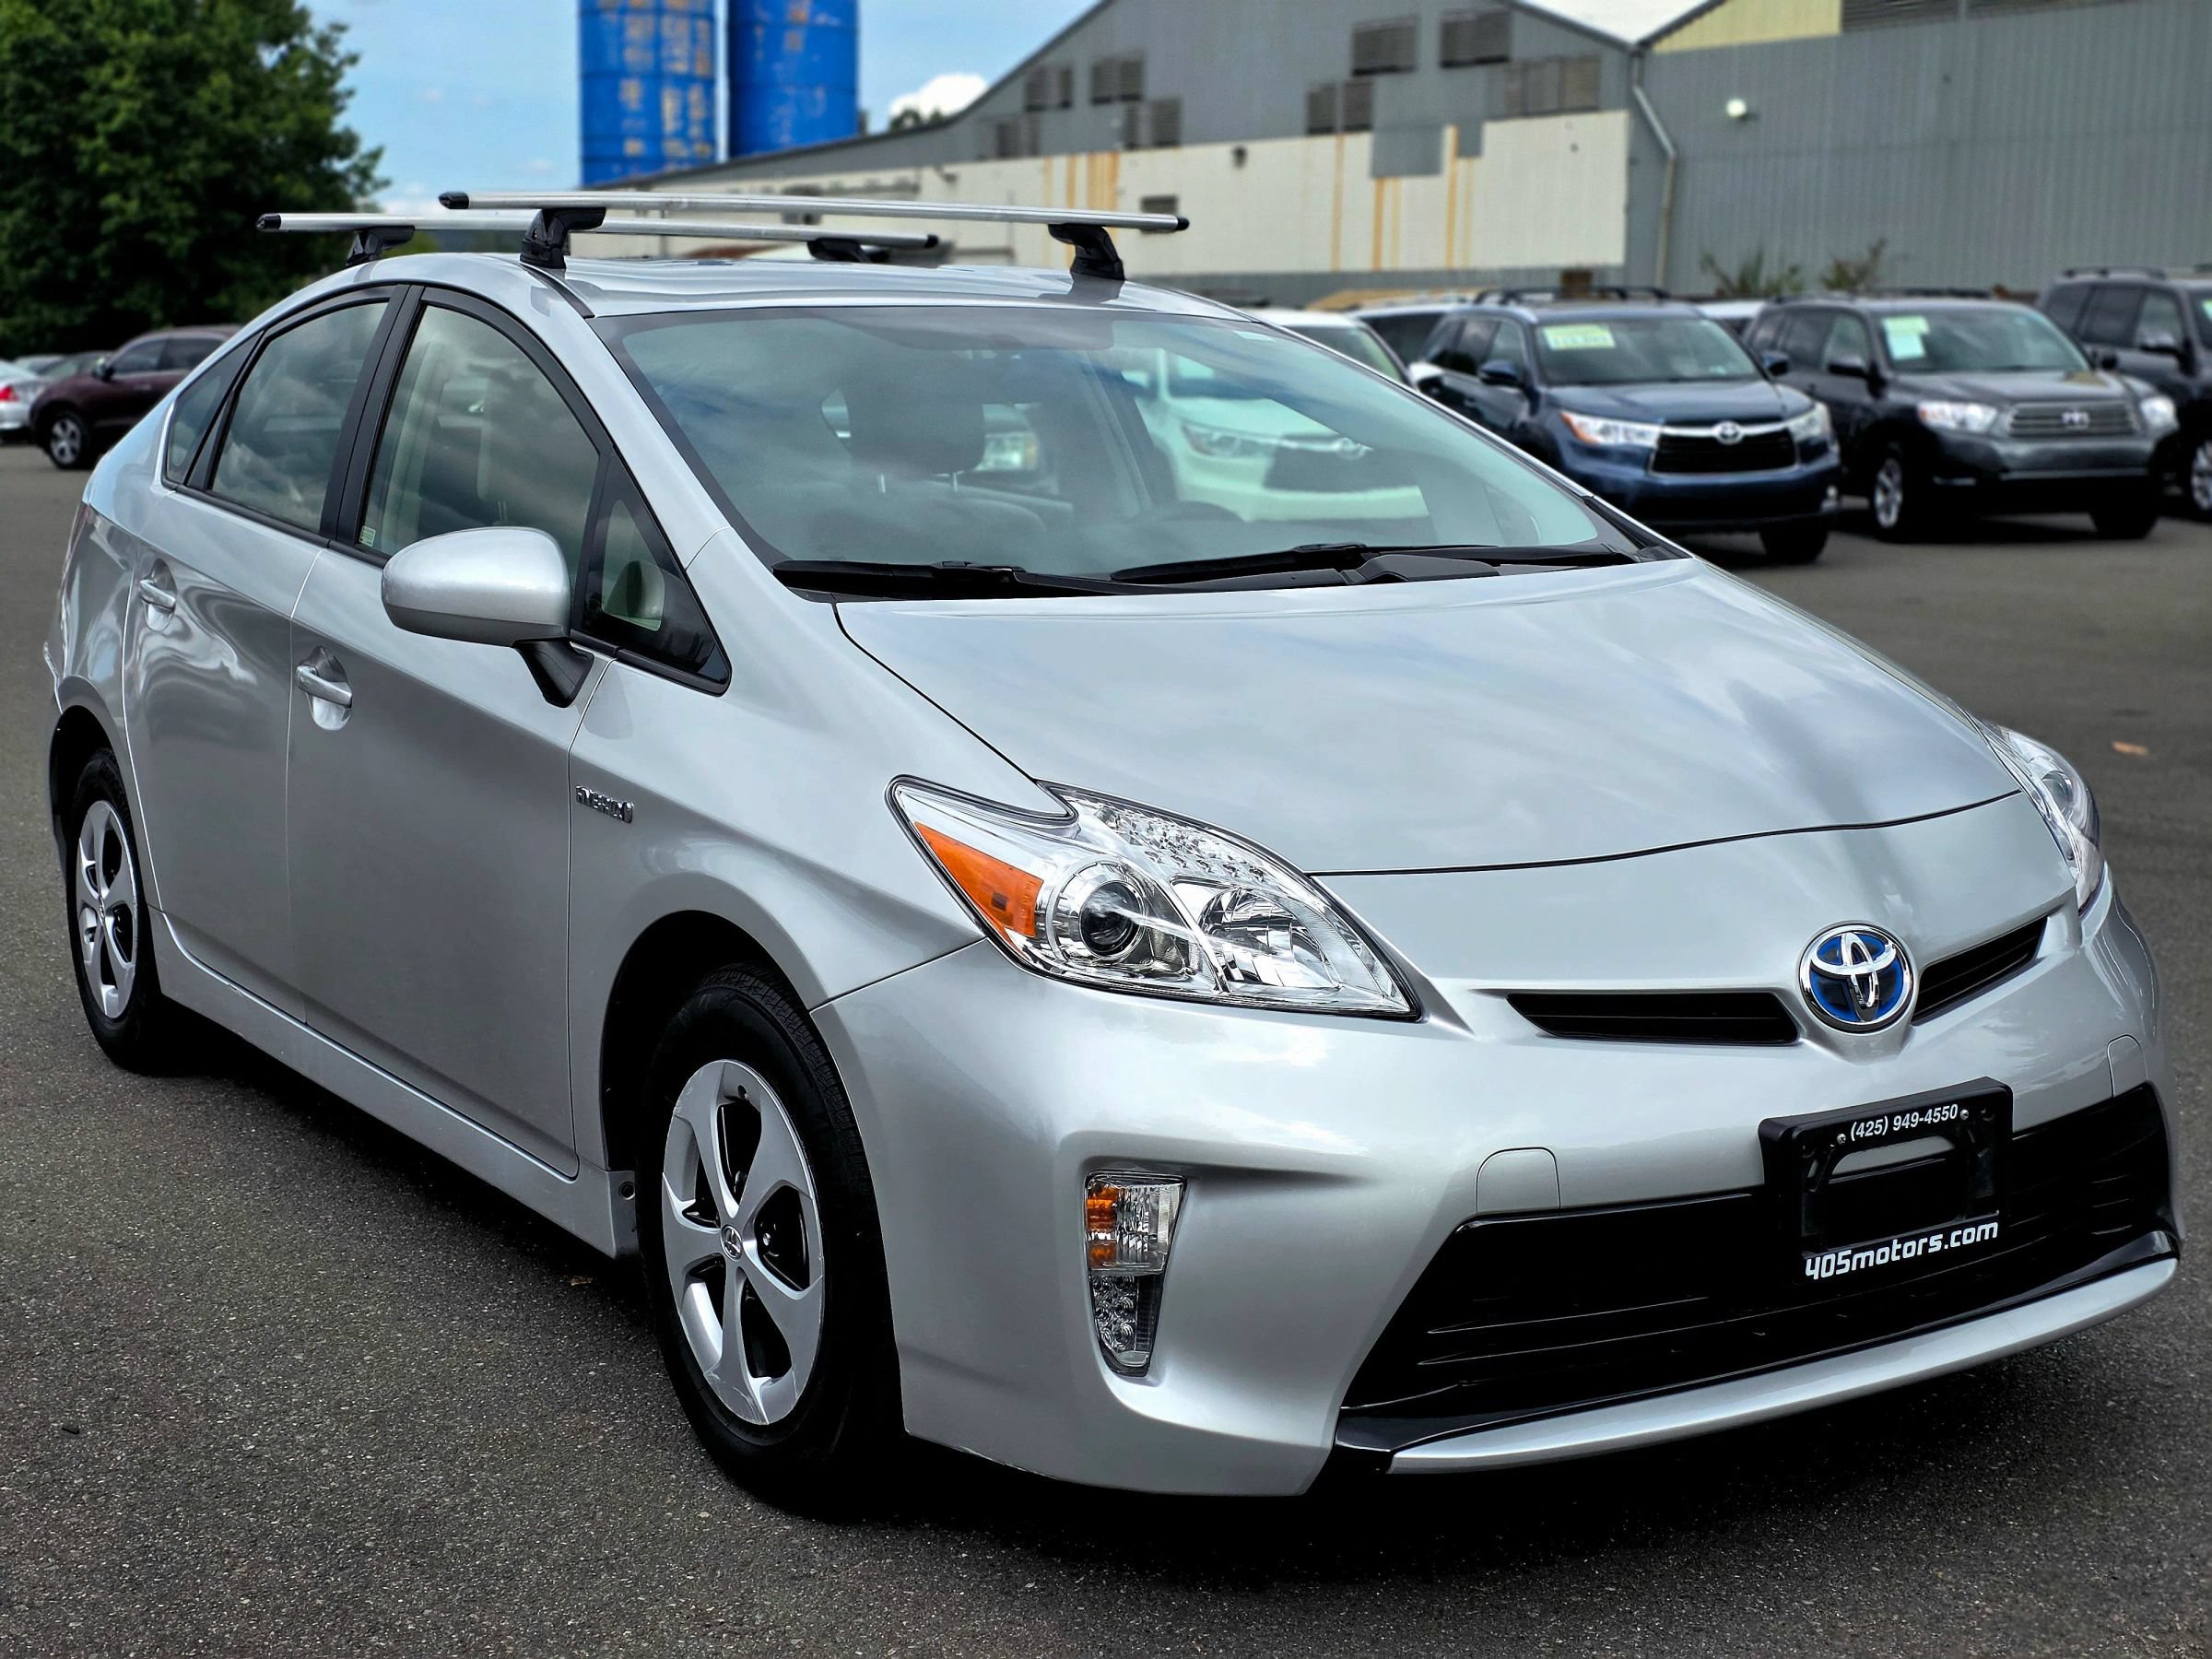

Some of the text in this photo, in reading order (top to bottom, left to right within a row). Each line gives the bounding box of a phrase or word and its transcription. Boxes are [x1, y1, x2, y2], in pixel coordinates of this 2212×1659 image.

[1850, 1103, 1959, 1142] (425) 949-4550
[1805, 1221, 1999, 1280] 405motors.com
